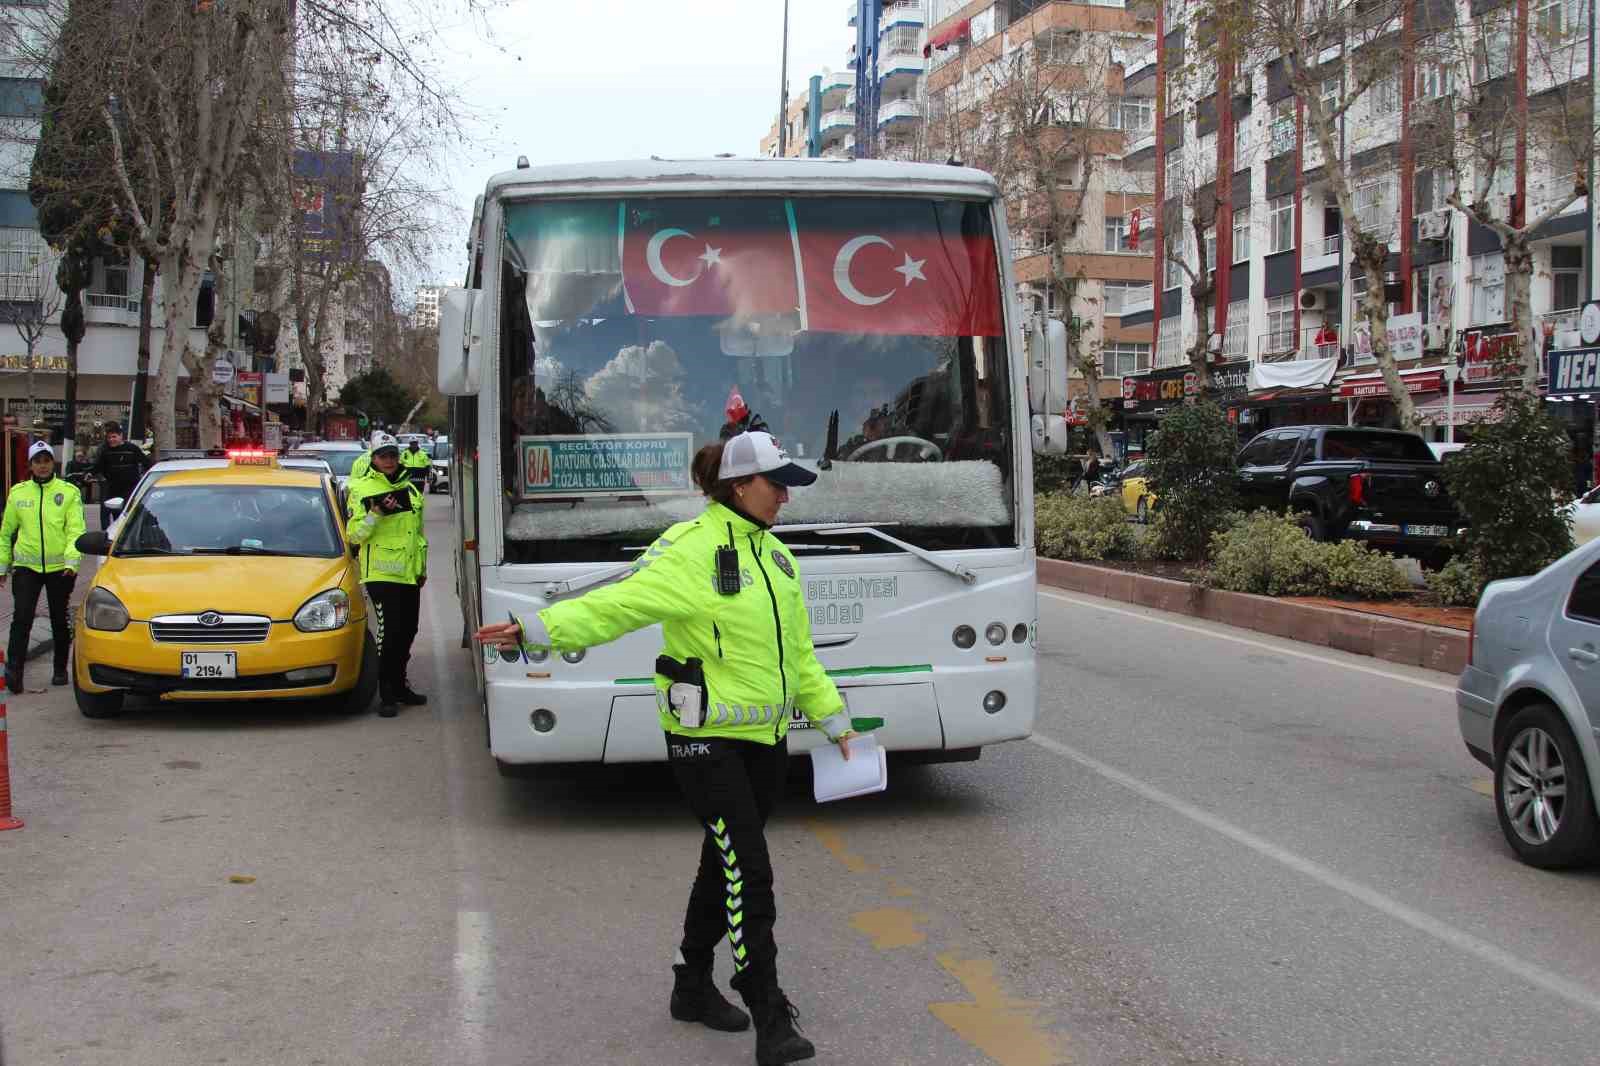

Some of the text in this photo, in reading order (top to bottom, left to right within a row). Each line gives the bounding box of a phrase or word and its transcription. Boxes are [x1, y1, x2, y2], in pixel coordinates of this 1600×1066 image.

[1556, 352, 1600, 390] HEC
[185, 654, 232, 665] 01 T
[196, 666, 222, 676] 2194
